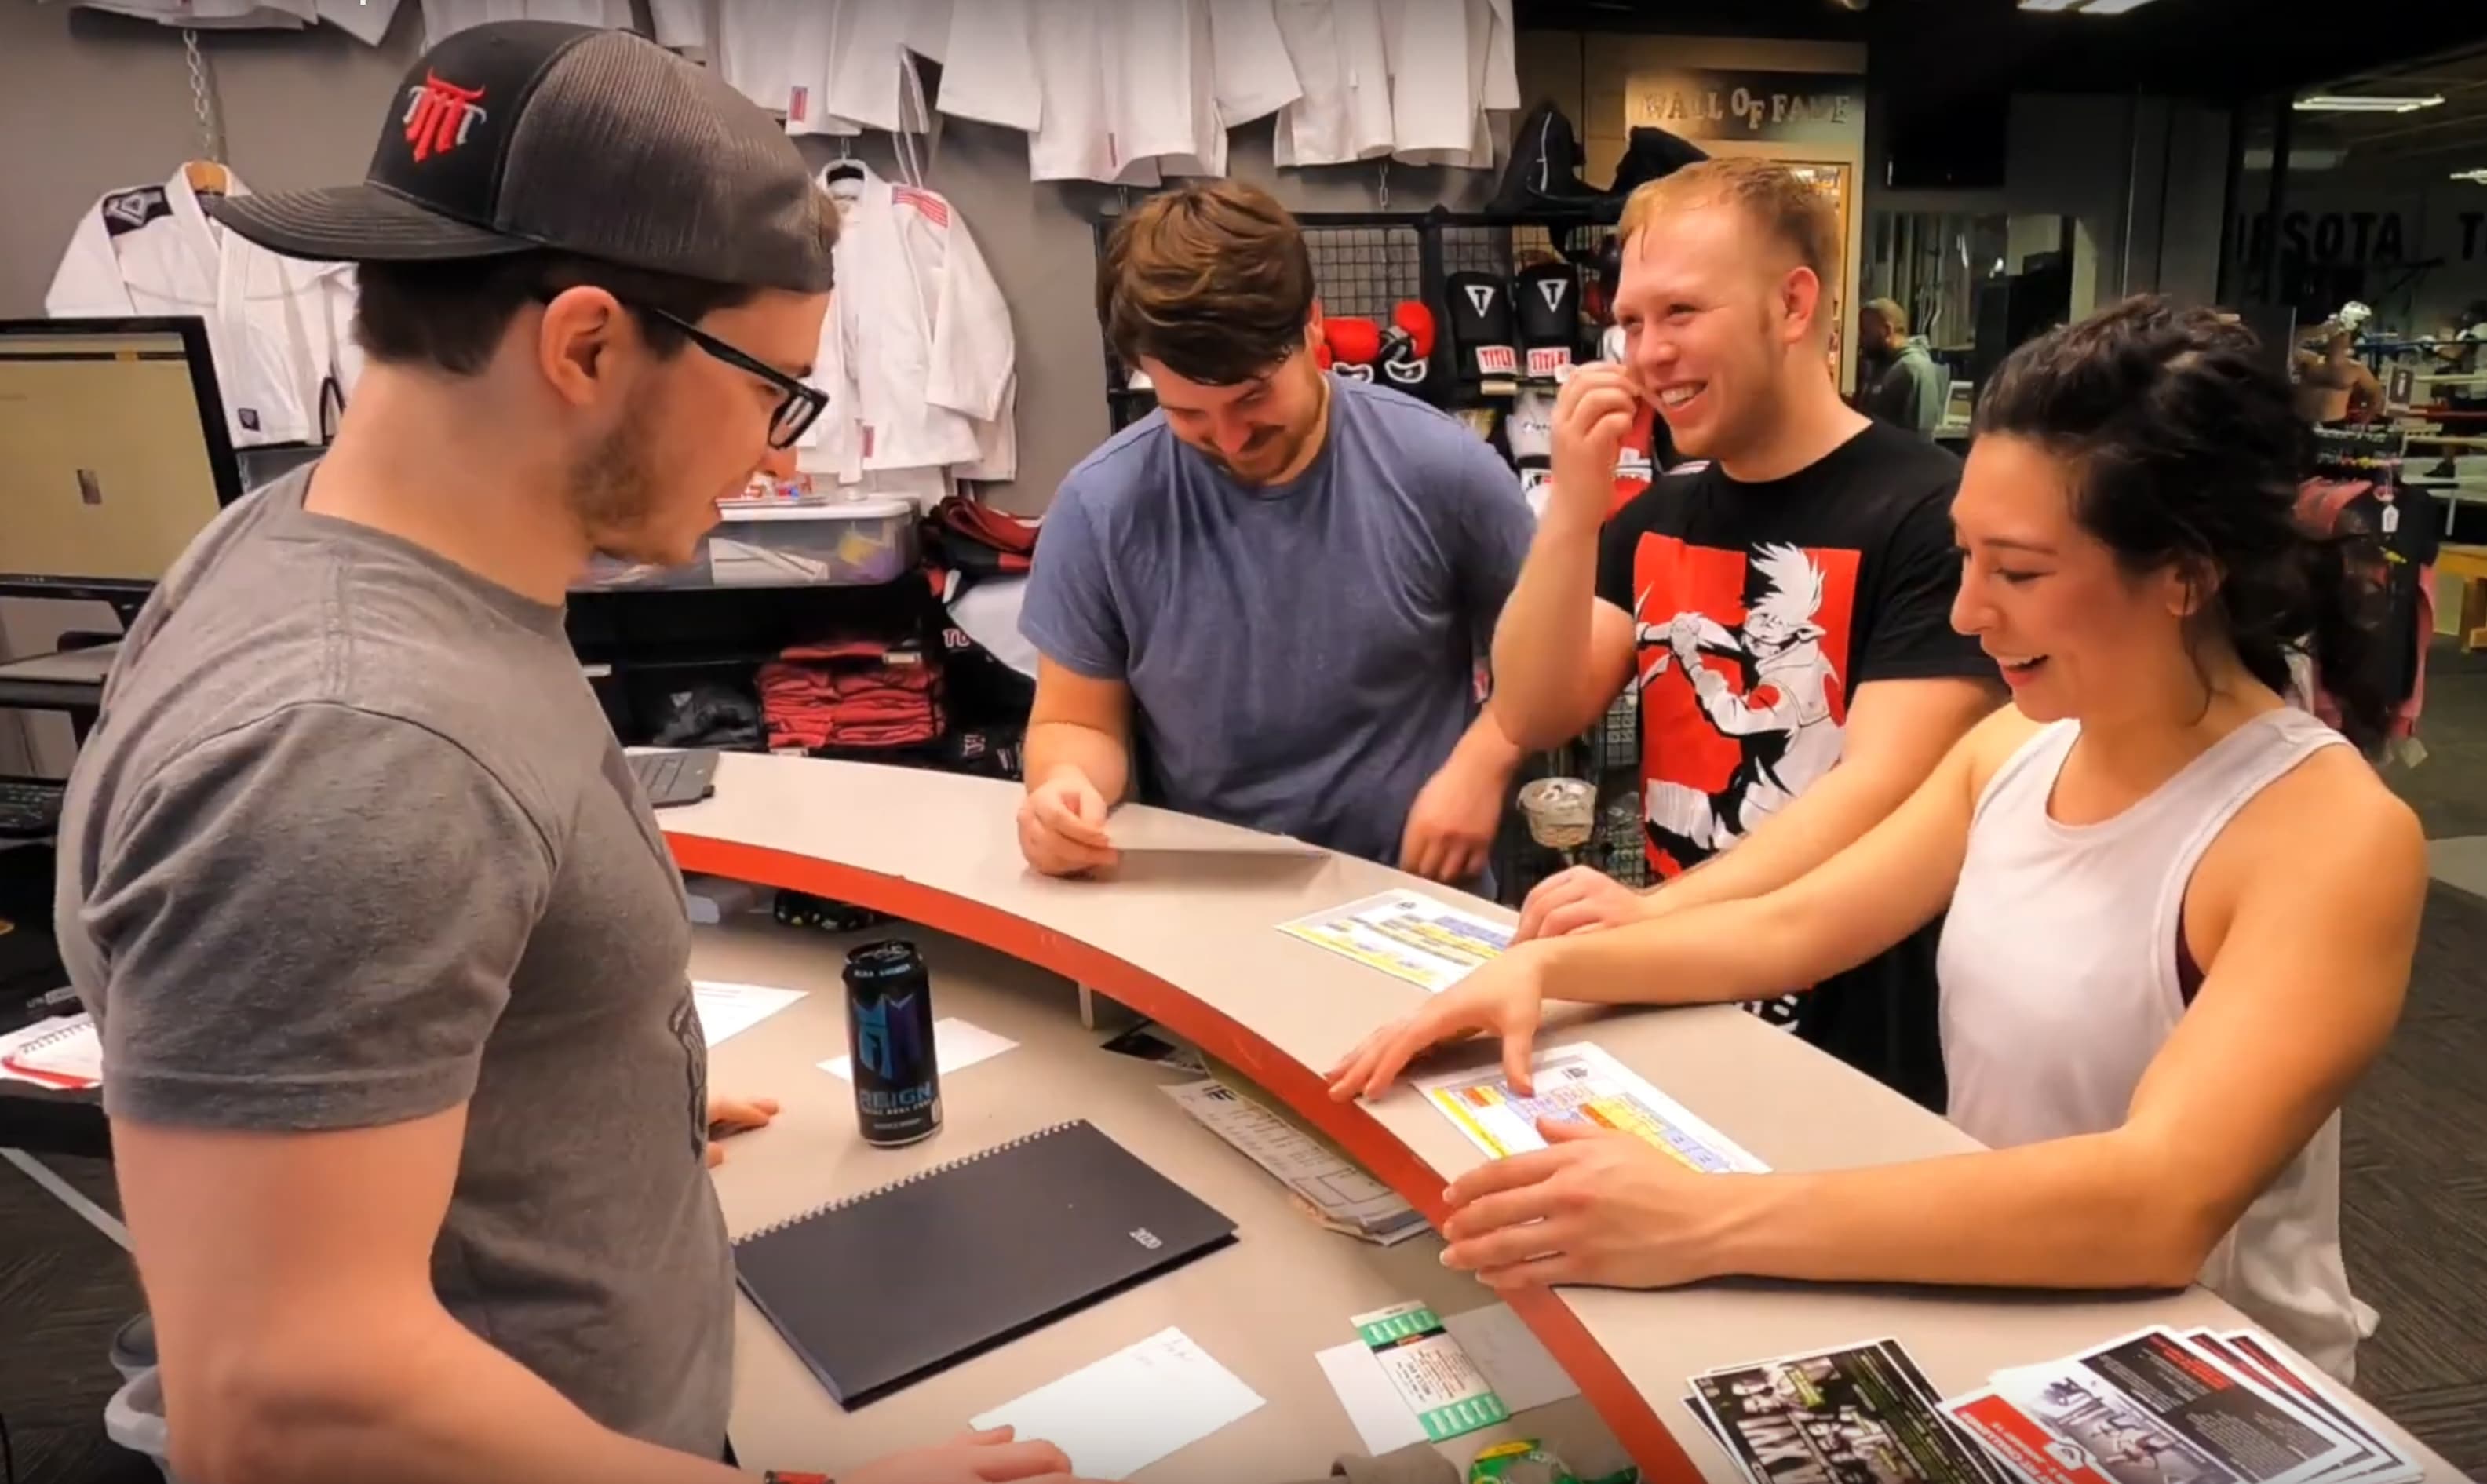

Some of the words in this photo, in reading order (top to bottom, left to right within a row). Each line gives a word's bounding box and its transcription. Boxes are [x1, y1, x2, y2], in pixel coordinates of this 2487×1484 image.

[1643, 91, 1723, 120] WALL
[1731, 87, 1765, 129] OF
[1771, 93, 1850, 123] FAME
[859, 1081, 932, 1110] REIGN
